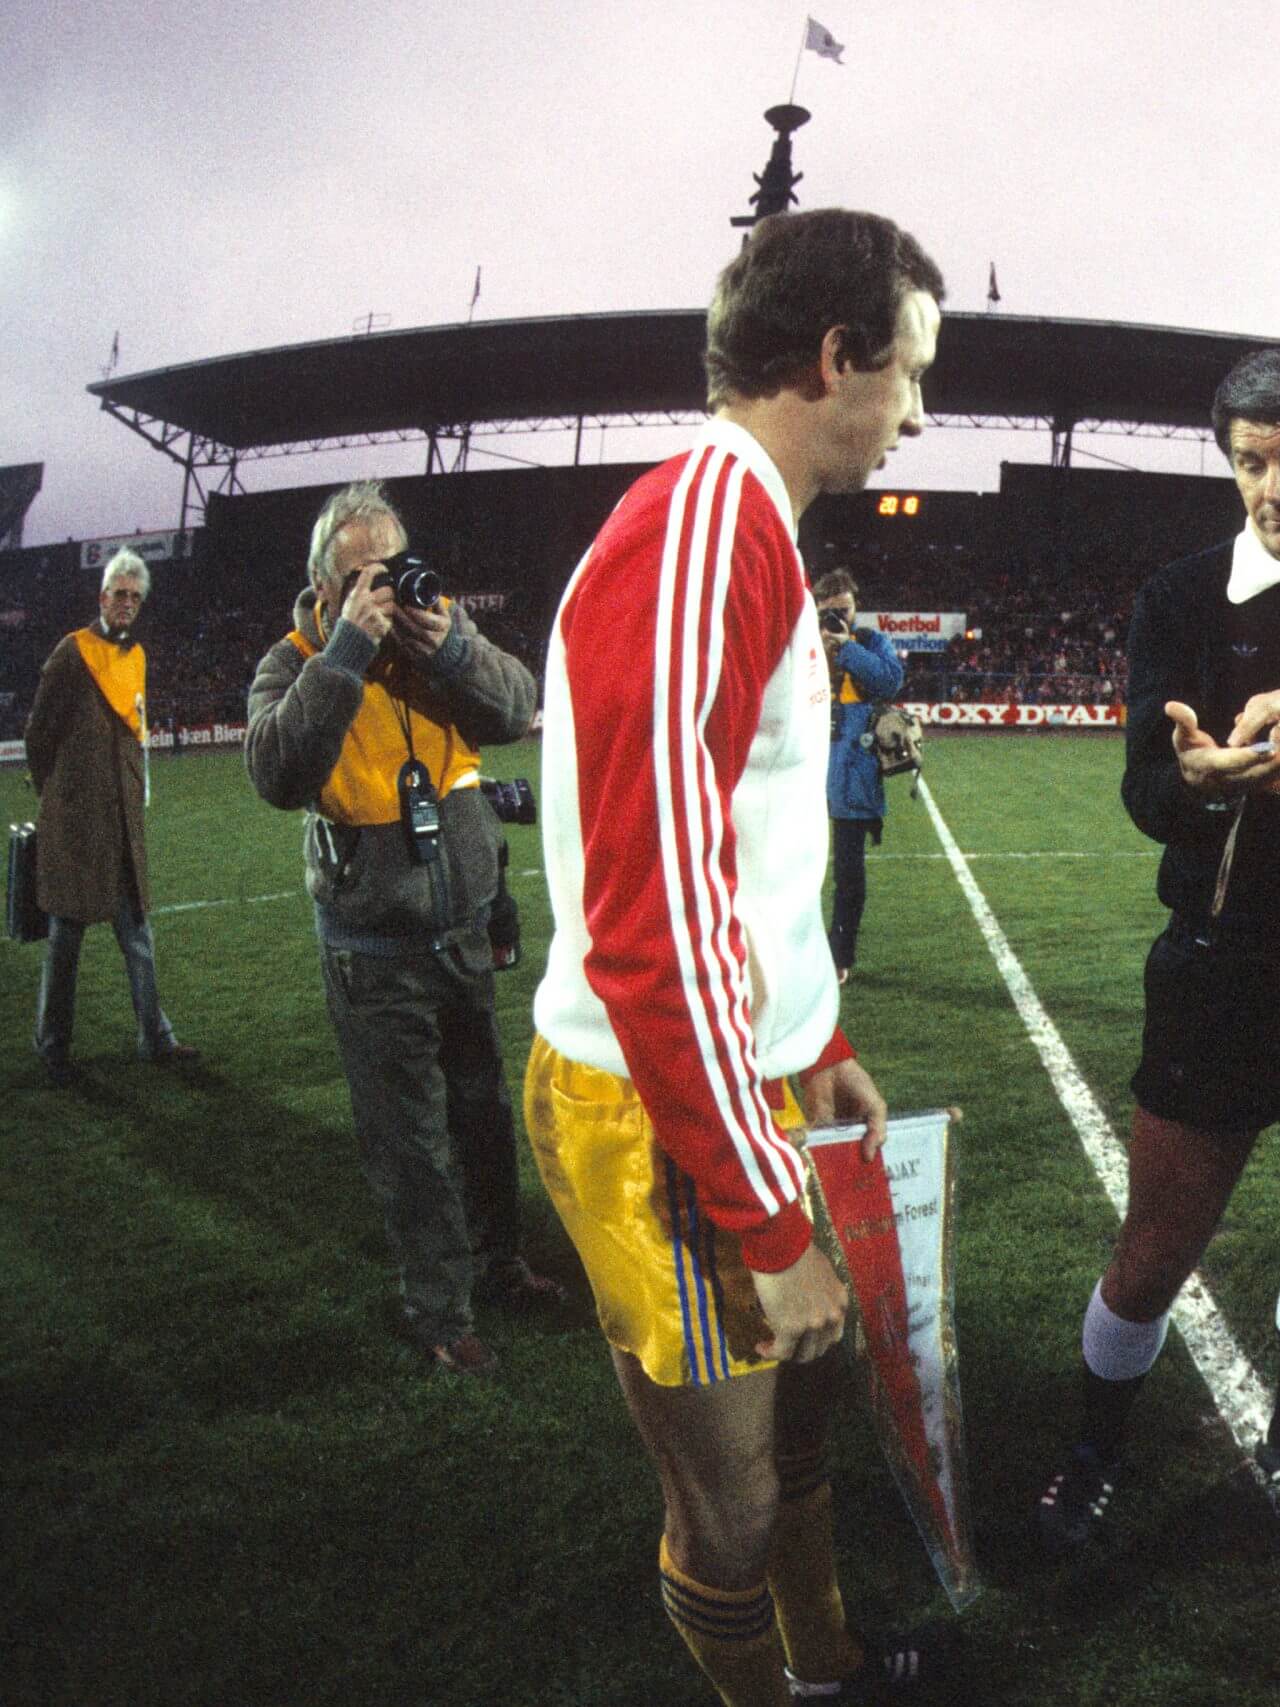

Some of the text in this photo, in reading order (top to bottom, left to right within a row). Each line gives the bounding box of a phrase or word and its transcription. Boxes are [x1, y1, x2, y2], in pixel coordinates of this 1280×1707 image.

[877, 614, 941, 633] Voetbal
[903, 702, 1011, 725] ROXY
[212, 723, 246, 742] Bier
[904, 1199, 938, 1223] Forest
